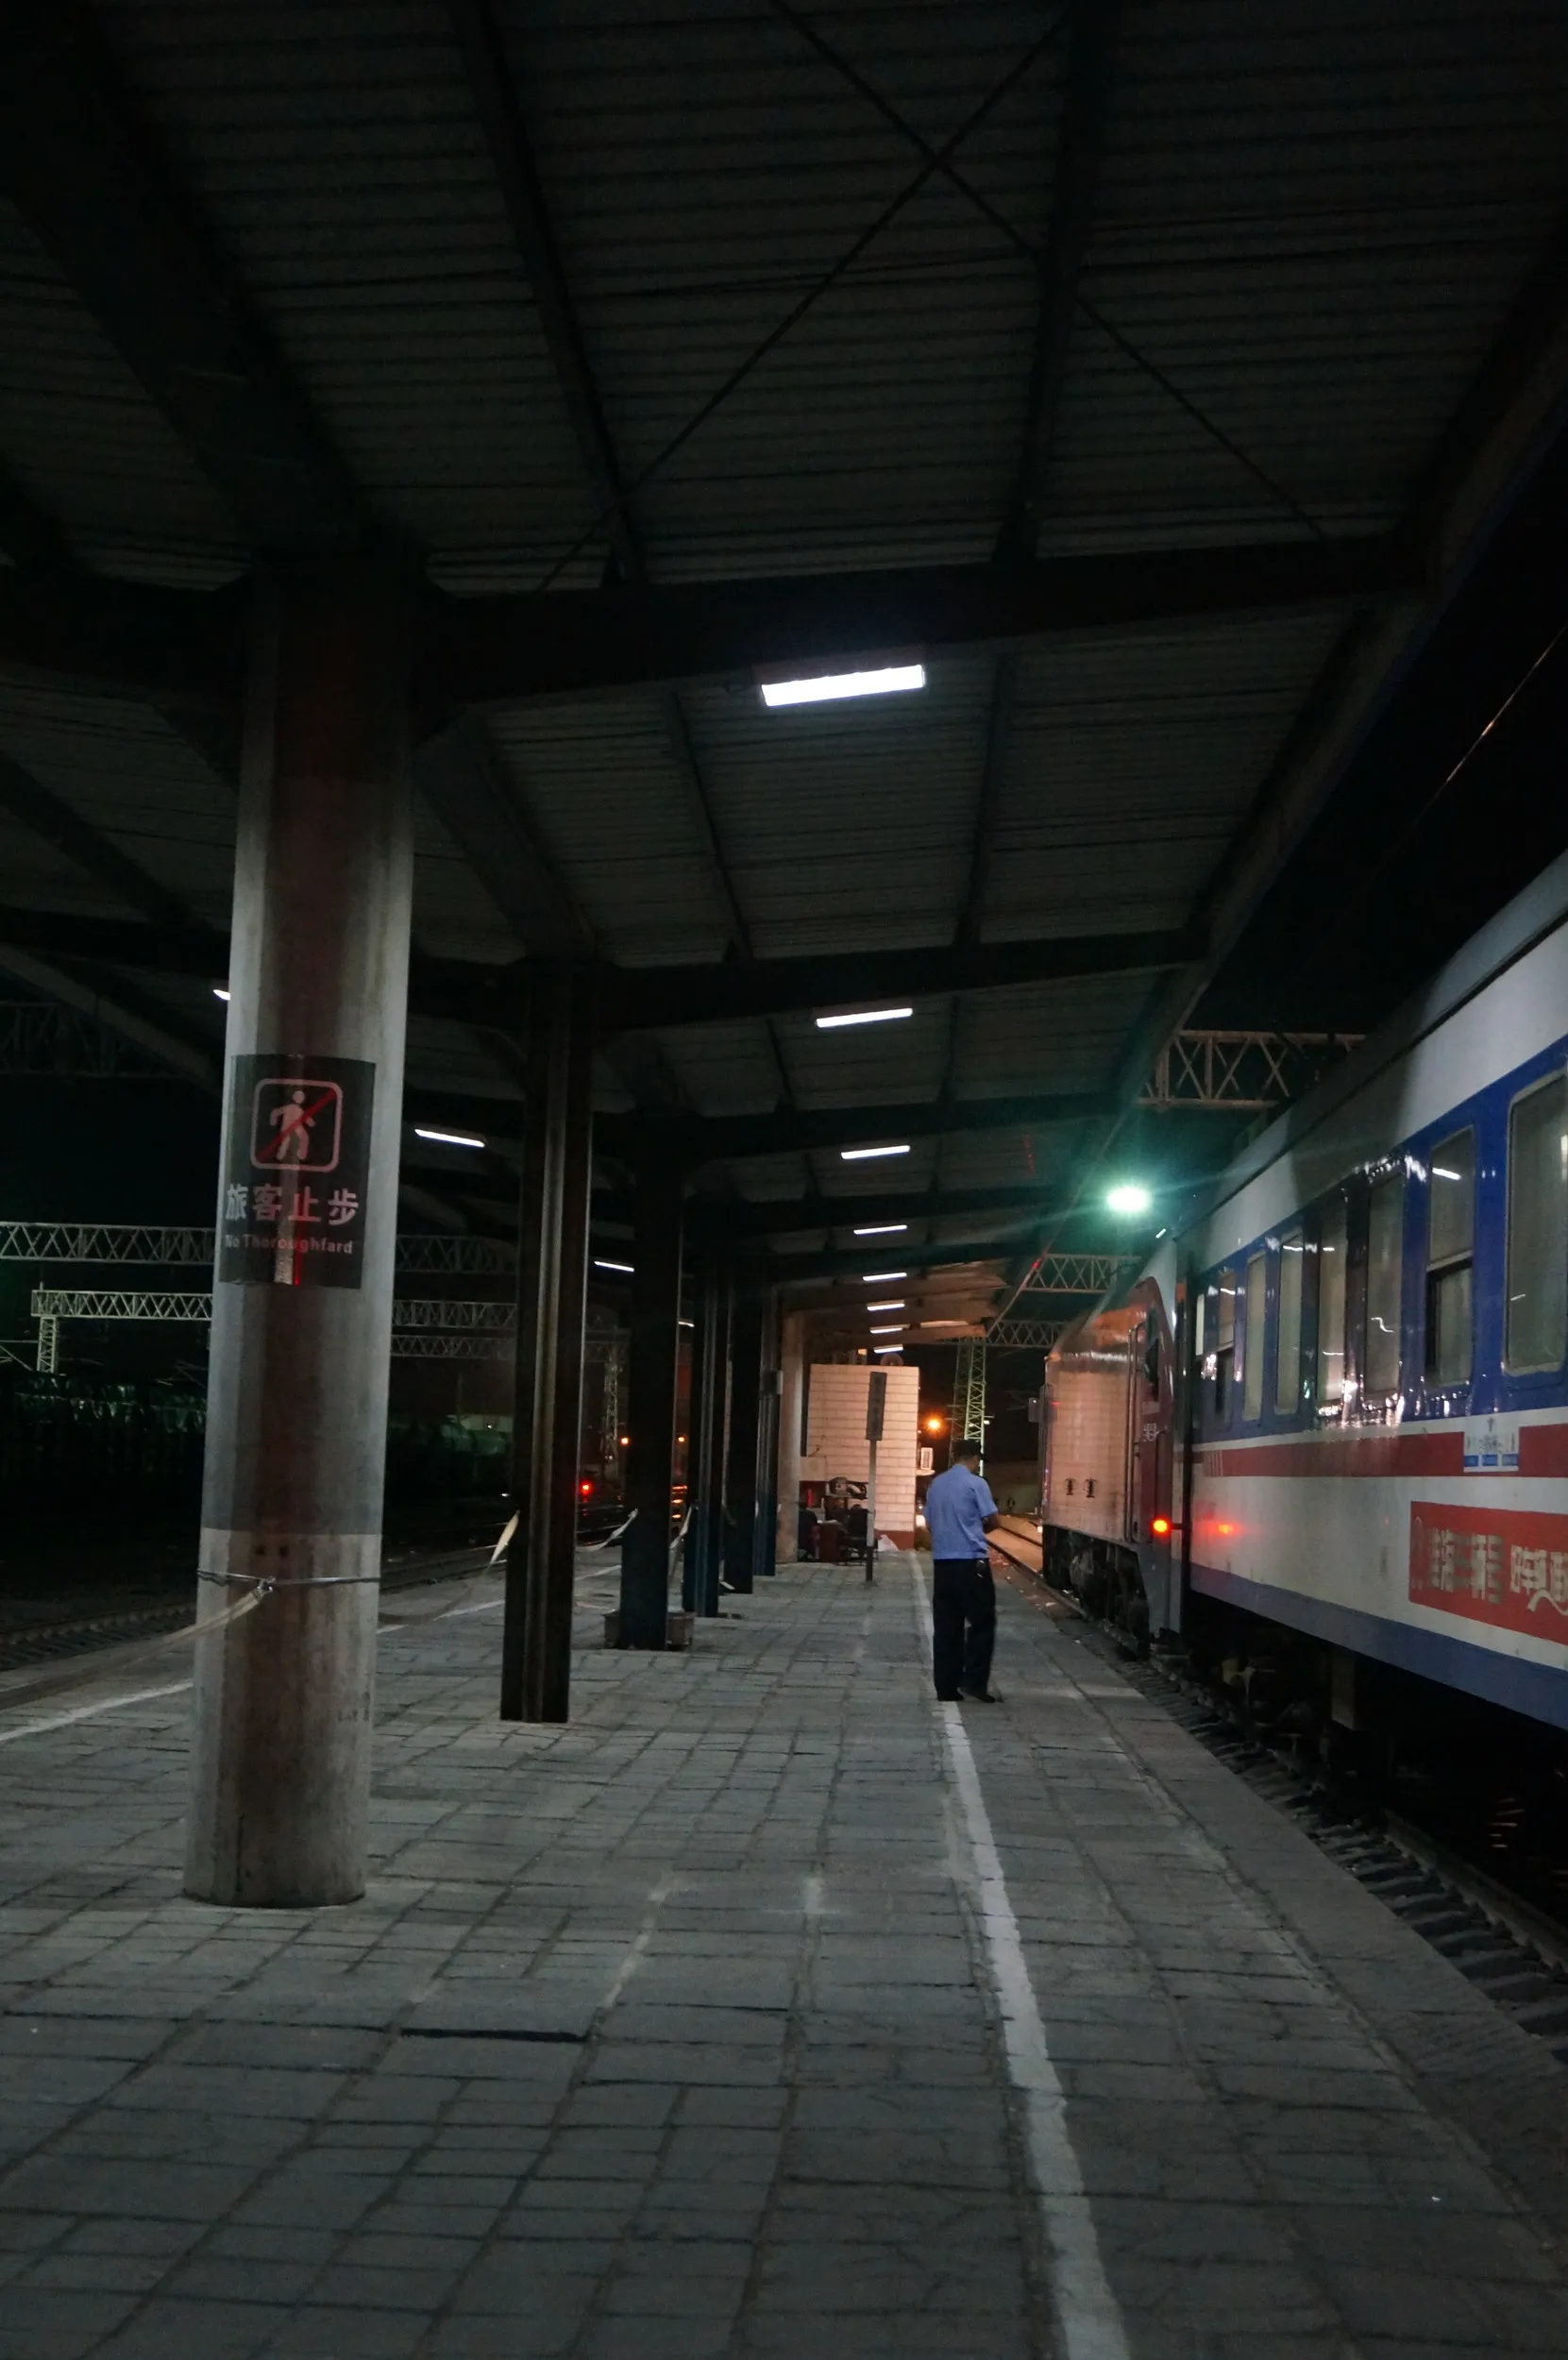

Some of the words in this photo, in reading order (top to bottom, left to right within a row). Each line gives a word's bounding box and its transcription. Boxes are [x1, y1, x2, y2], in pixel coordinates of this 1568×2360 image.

[226, 1183, 360, 1226] 旅客止步
[225, 1234, 240, 1248] No
